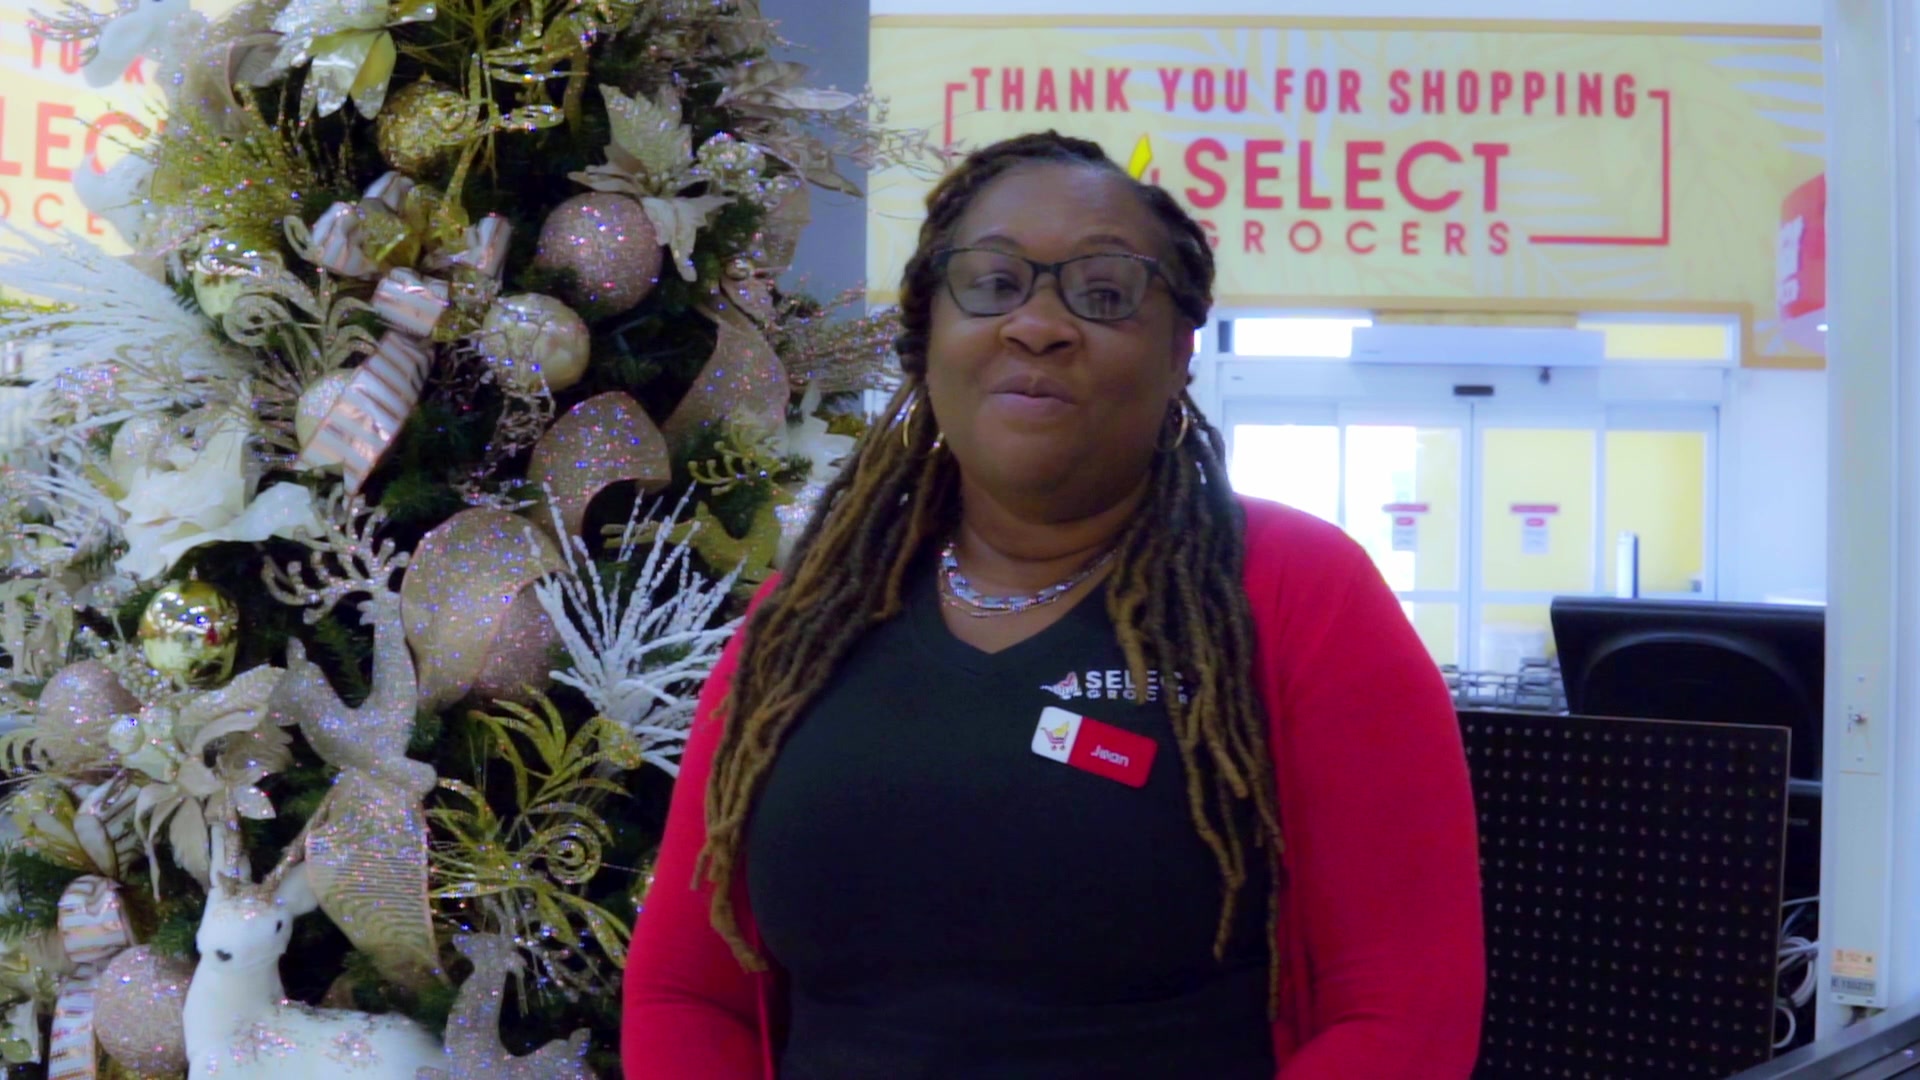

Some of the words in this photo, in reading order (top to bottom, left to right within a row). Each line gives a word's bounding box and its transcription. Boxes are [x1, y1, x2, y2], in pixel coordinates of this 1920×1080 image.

[971, 68, 1129, 112] THANK
[1159, 68, 1248, 114] YOU
[1275, 68, 1362, 114] FOR
[1388, 69, 1638, 118] SHOPPING
[0, 96, 168, 183] LEC
[1184, 138, 1509, 213] SELECT
